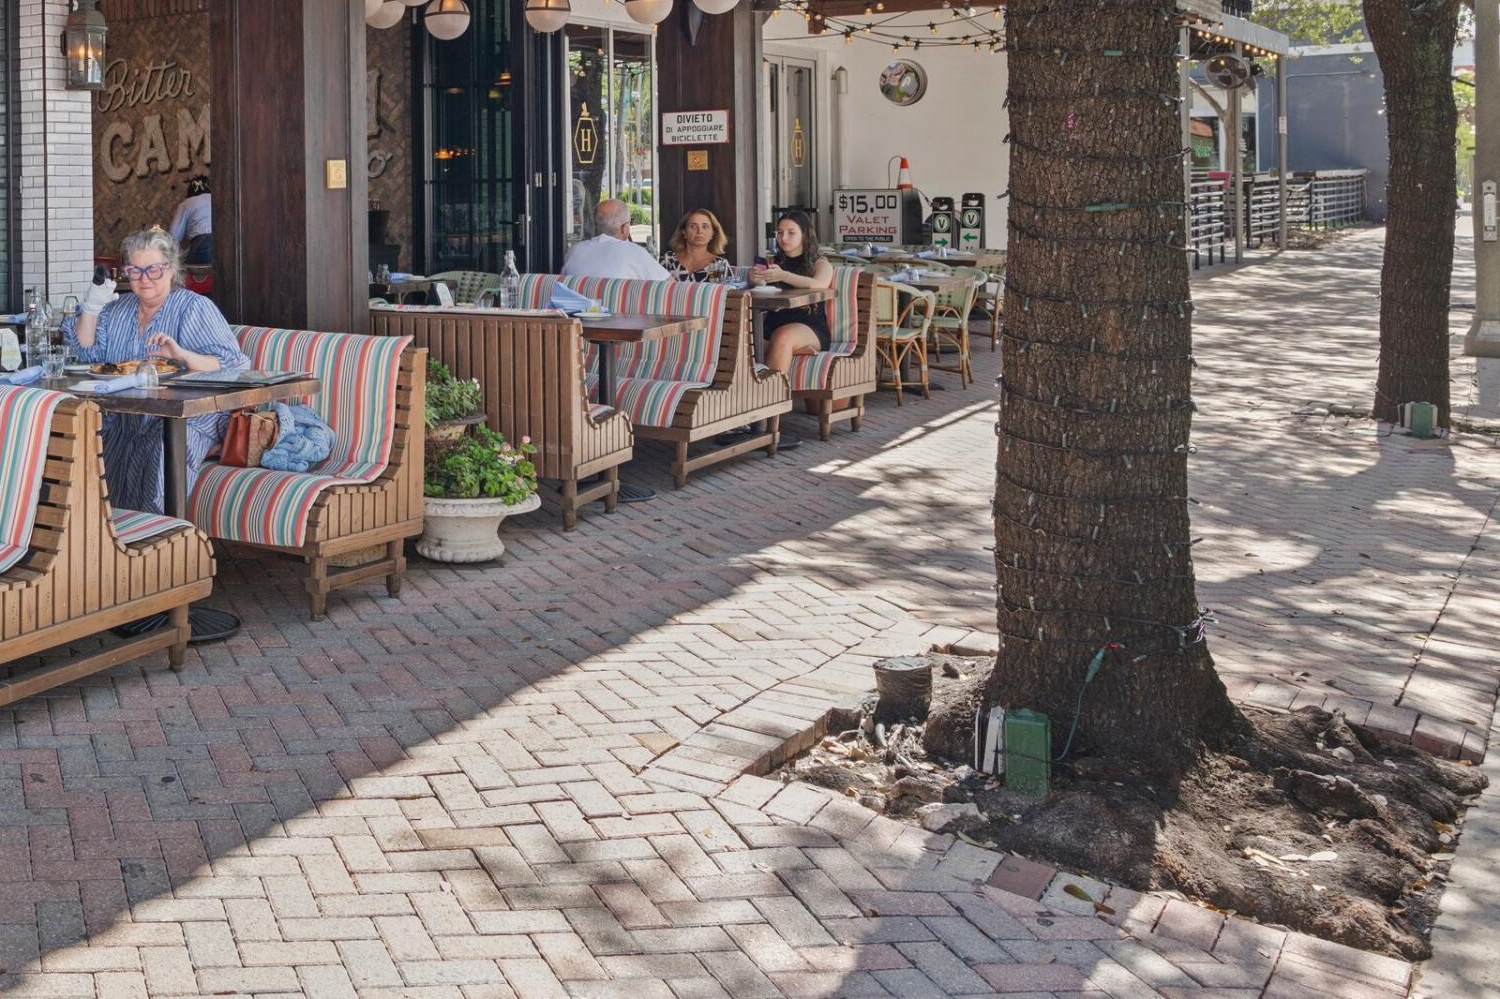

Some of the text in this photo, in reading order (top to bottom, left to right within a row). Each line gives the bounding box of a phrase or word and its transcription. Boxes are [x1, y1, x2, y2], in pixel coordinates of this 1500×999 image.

[97, 58, 195, 112] Bitter
[676, 113, 713, 124] DIVIETO
[677, 125, 724, 133] APPOGGIARE
[580, 128, 592, 152] H
[671, 134, 718, 142] BICICLETTE
[839, 194, 897, 214] $15.00
[846, 215, 890, 224] VALET
[938, 219, 946, 228] V
[967, 214, 975, 224] V
[839, 225, 897, 234] PARKING
